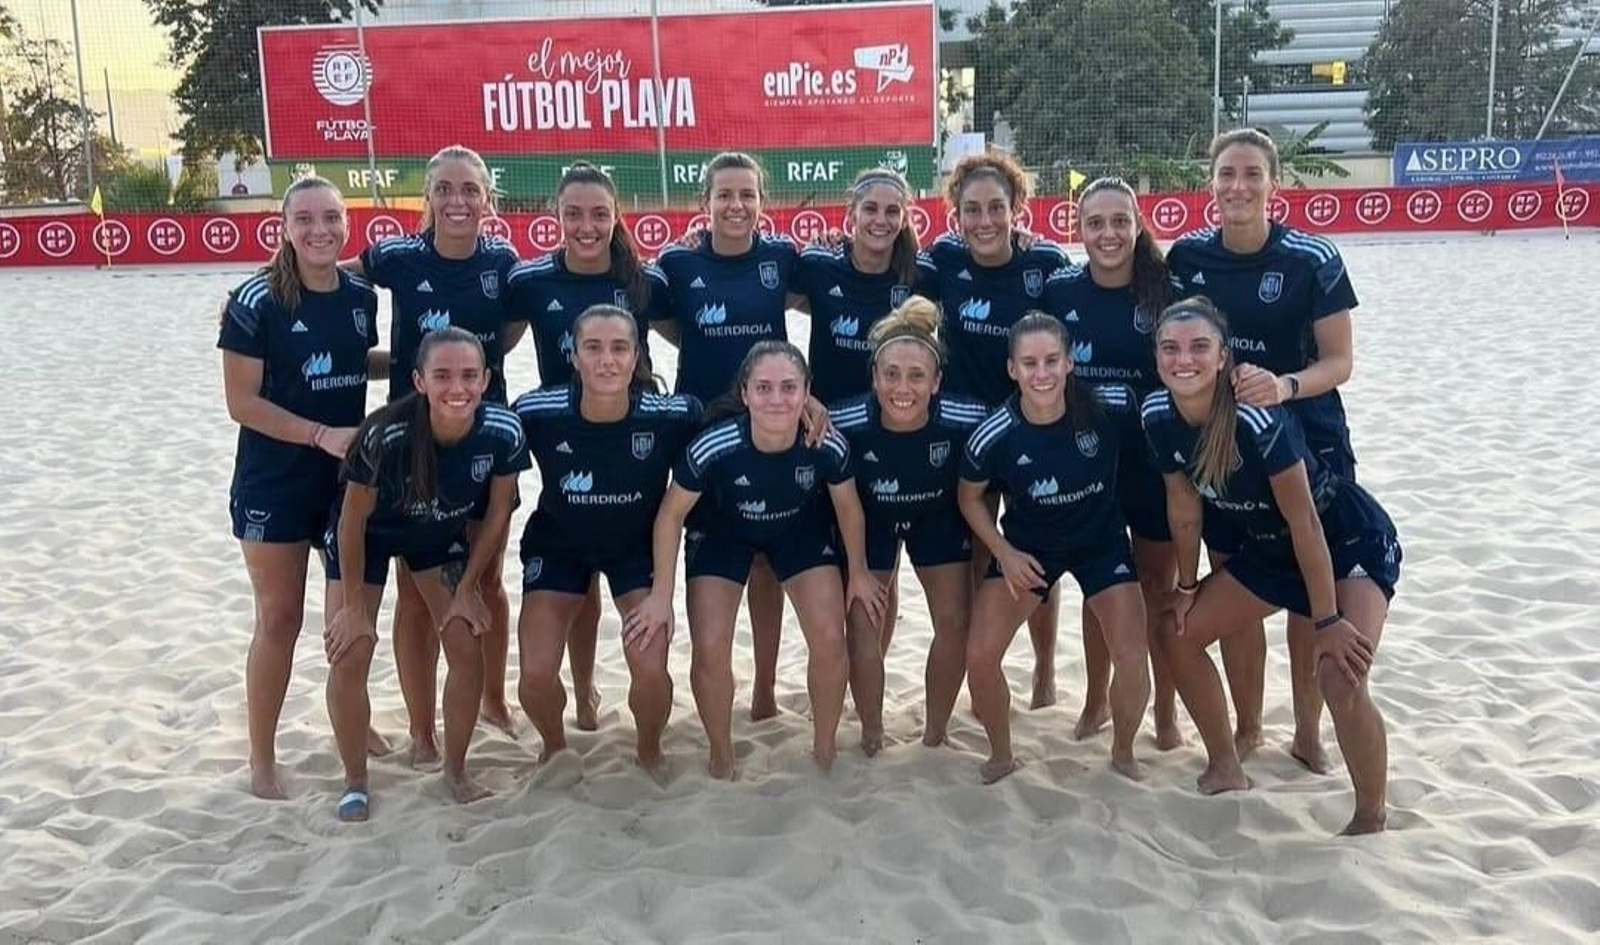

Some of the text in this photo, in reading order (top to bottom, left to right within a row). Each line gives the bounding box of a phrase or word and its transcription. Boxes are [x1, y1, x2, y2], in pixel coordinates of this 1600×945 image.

[528, 37, 631, 94] el mejor
[763, 61, 857, 97] enPie.es
[483, 74, 696, 131] FÚTBOL PLAYA
[324, 130, 369, 141] PLAYA
[348, 169, 396, 188] RFAF
[673, 164, 709, 183] RFA
[788, 161, 840, 181] RFAF
[704, 323, 772, 337] IBERDROLA
[963, 320, 1010, 338] IBERDR
[1074, 365, 1143, 379] BERDROLA
[311, 373, 368, 391] IBERDROA
[568, 491, 642, 504] IBERDROLA
